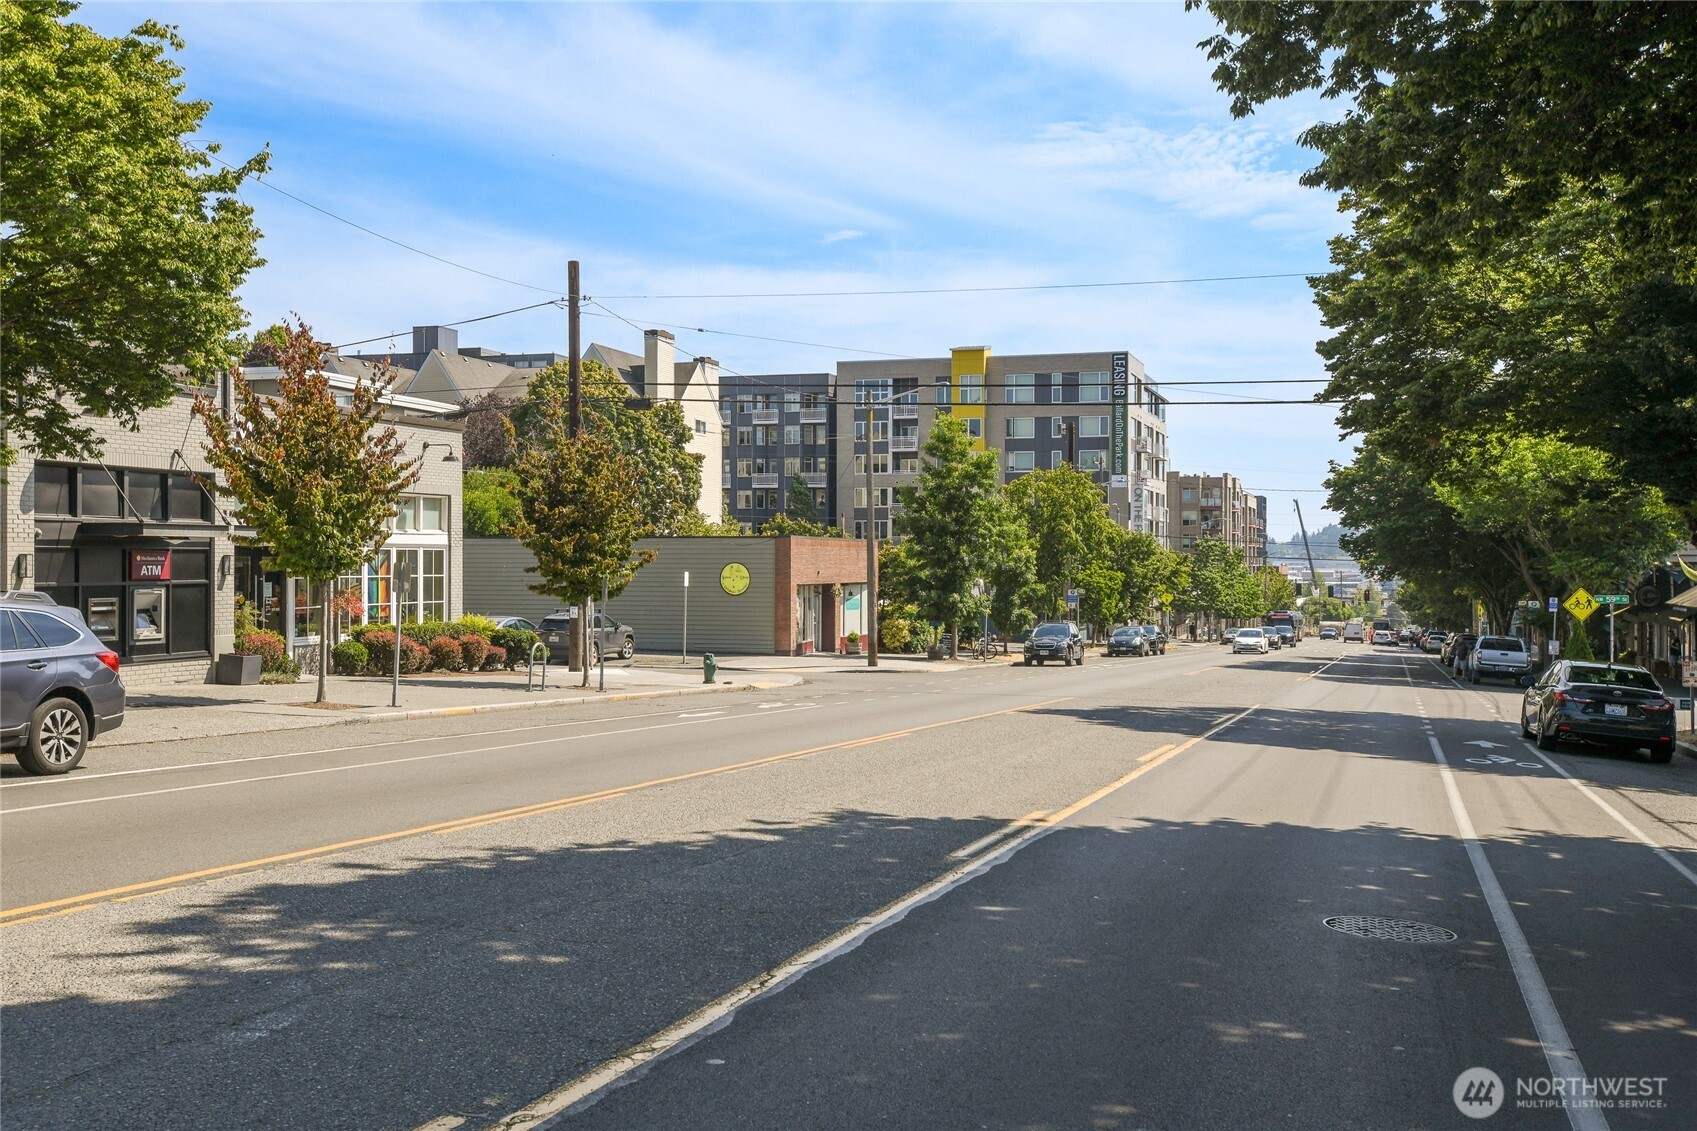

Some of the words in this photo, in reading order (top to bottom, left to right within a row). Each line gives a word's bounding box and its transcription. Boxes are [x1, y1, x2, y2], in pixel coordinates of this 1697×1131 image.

[1113, 355, 1126, 396] LEASING
[1115, 399, 1124, 474] BallardOnThePark.com
[1134, 487, 1143, 502] ON
[1134, 504, 1143, 522] THE
[140, 565, 162, 576] ATM
